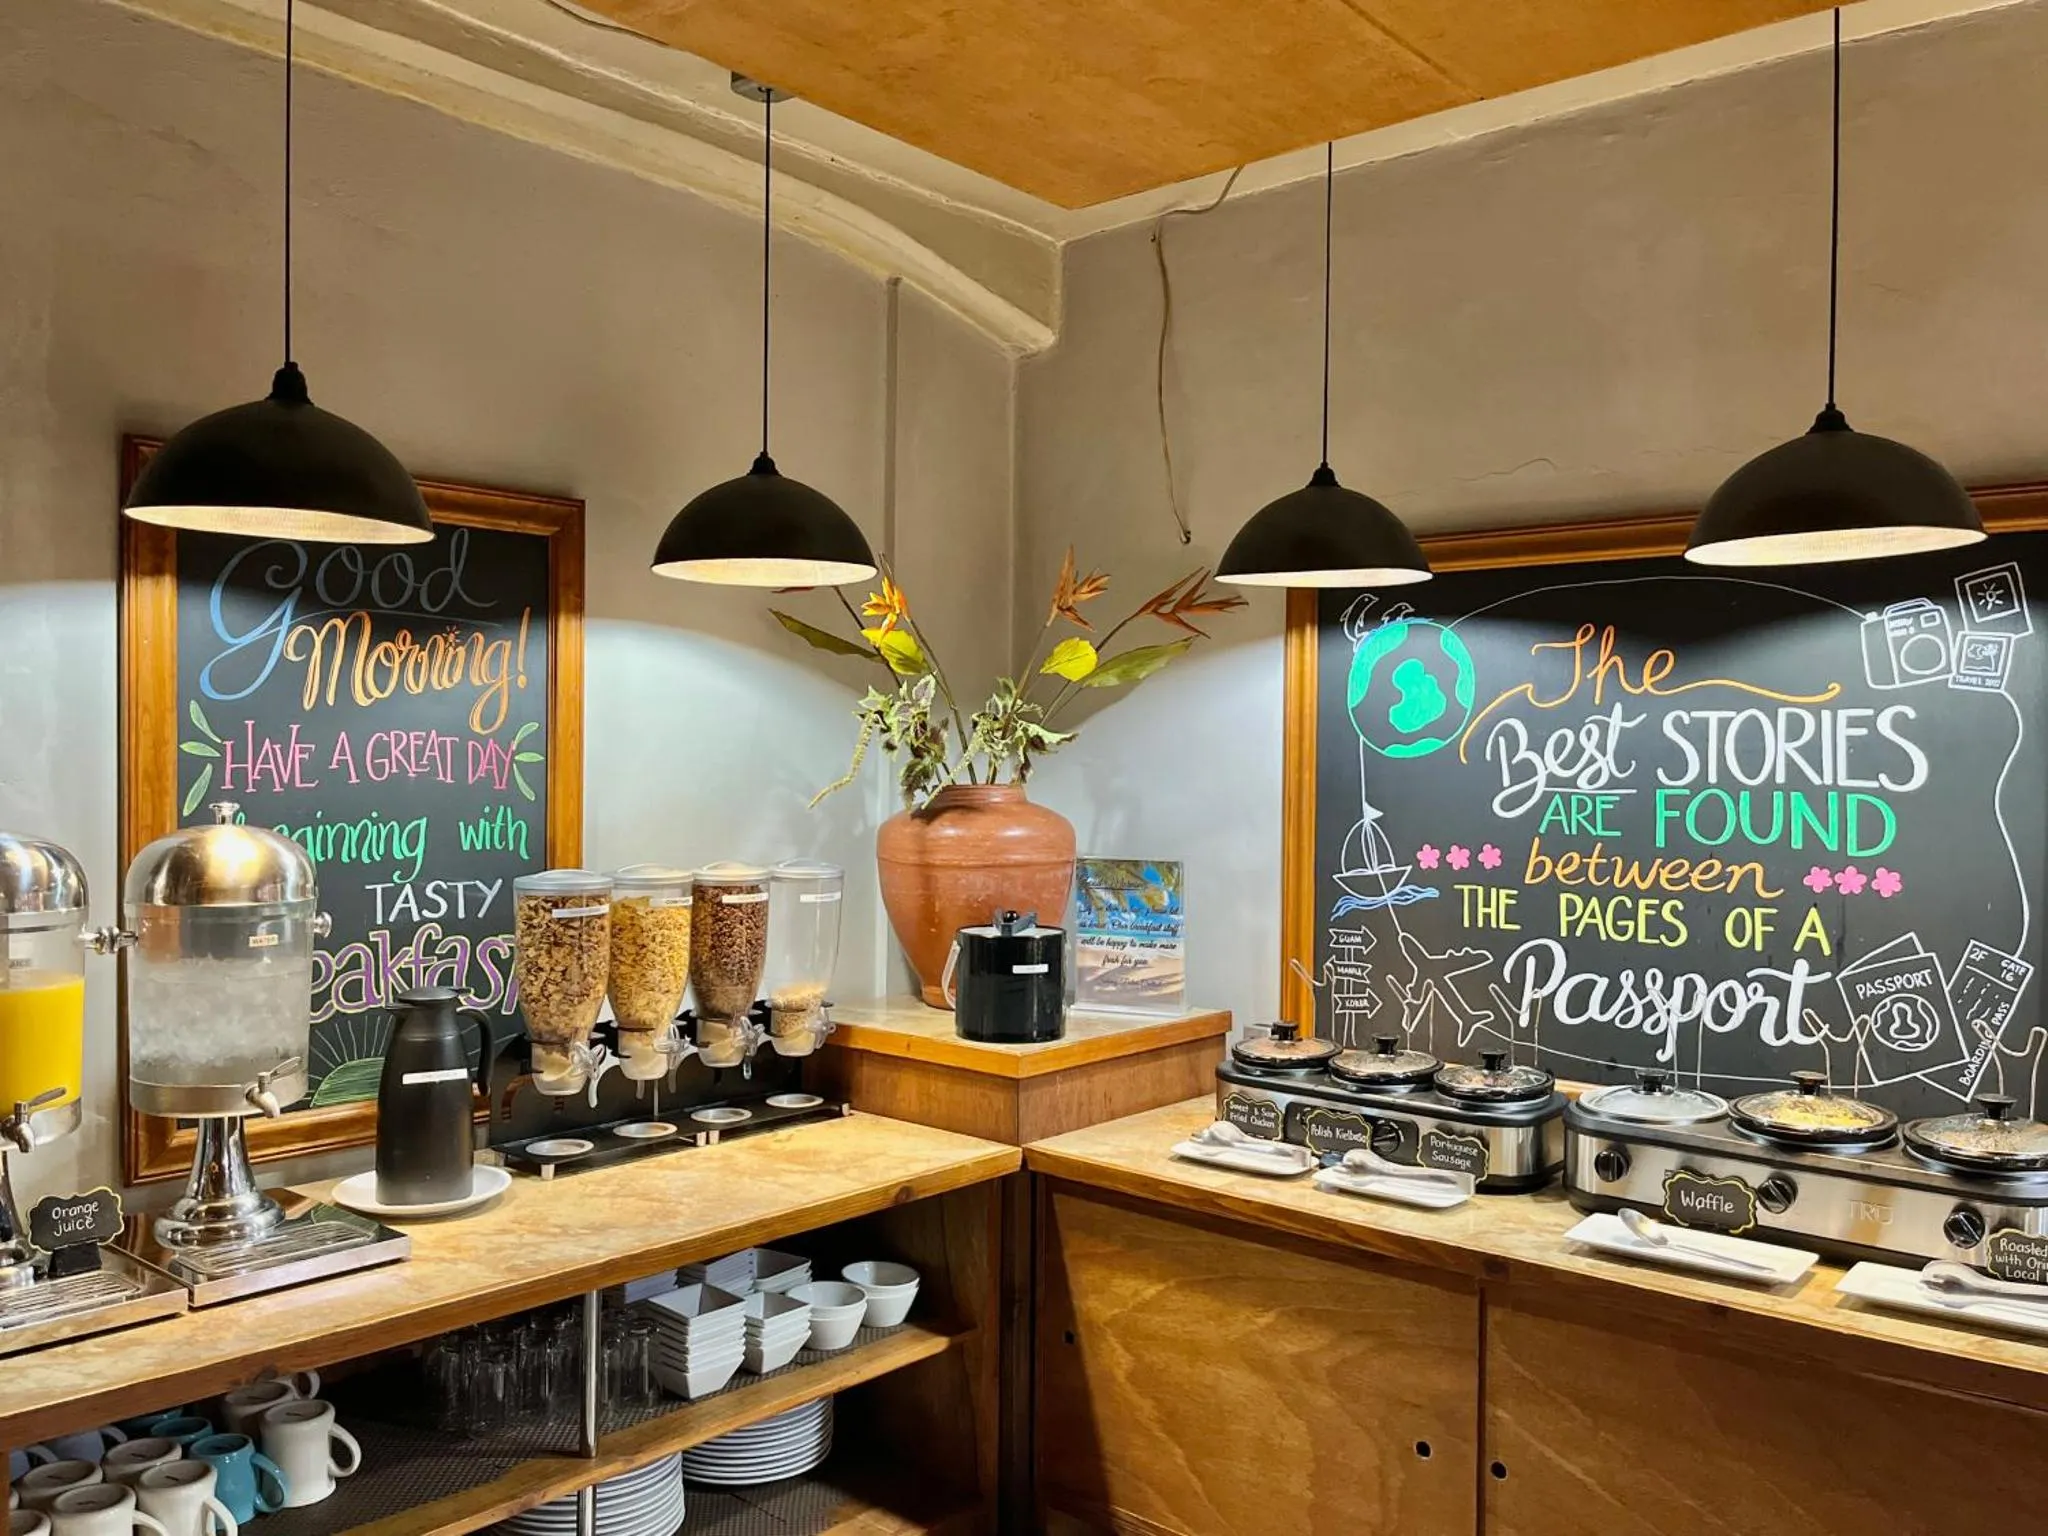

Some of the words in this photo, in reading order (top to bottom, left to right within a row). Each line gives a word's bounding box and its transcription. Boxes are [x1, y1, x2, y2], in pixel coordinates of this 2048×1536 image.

[201, 527, 500, 701] Good
[283, 604, 530, 735] Morning!
[220, 720, 320, 792] HAVE
[328, 731, 360, 784] A
[365, 729, 460, 784] GREAT
[467, 737, 516, 790] DAY
[1485, 701, 1647, 819] Best
[1656, 704, 1929, 792] STORIES
[1538, 793, 1622, 837] ARE
[1655, 787, 1897, 857] FOUND
[236, 810, 428, 883] ginning
[458, 805, 530, 860] with
[1523, 836, 1785, 899] between
[364, 877, 503, 925] TASTY
[1453, 884, 1522, 931] THE
[1558, 892, 1688, 947] PAGES
[1724, 906, 1779, 952] OF
[1793, 906, 1832, 956] A
[1105, 937, 1128, 950] happy
[1338, 933, 1363, 944] GUAM
[1969, 948, 1989, 963] 2F
[2000, 958, 2027, 977] GATE
[2001, 969, 2015, 983] 16
[1855, 968, 1935, 1000] PASSPORT
[1502, 937, 1833, 1062] Passport
[1958, 1028, 1994, 1086] BOARDING
[1990, 1001, 2010, 1027] PASS
[1310, 1123, 1333, 1139] Polish
[1430, 1135, 1478, 1157] Portuguese
[1431, 1150, 1472, 1170] Sausage
[52, 1201, 100, 1220] Orange
[1680, 1189, 1736, 1214] Waffle
[53, 1217, 96, 1237] juice
[2000, 1237, 2048, 1258] Roasted
[1995, 1253, 2023, 1267] with
[2026, 1256, 2048, 1271] Oni
[2005, 1265, 2040, 1282] Local
